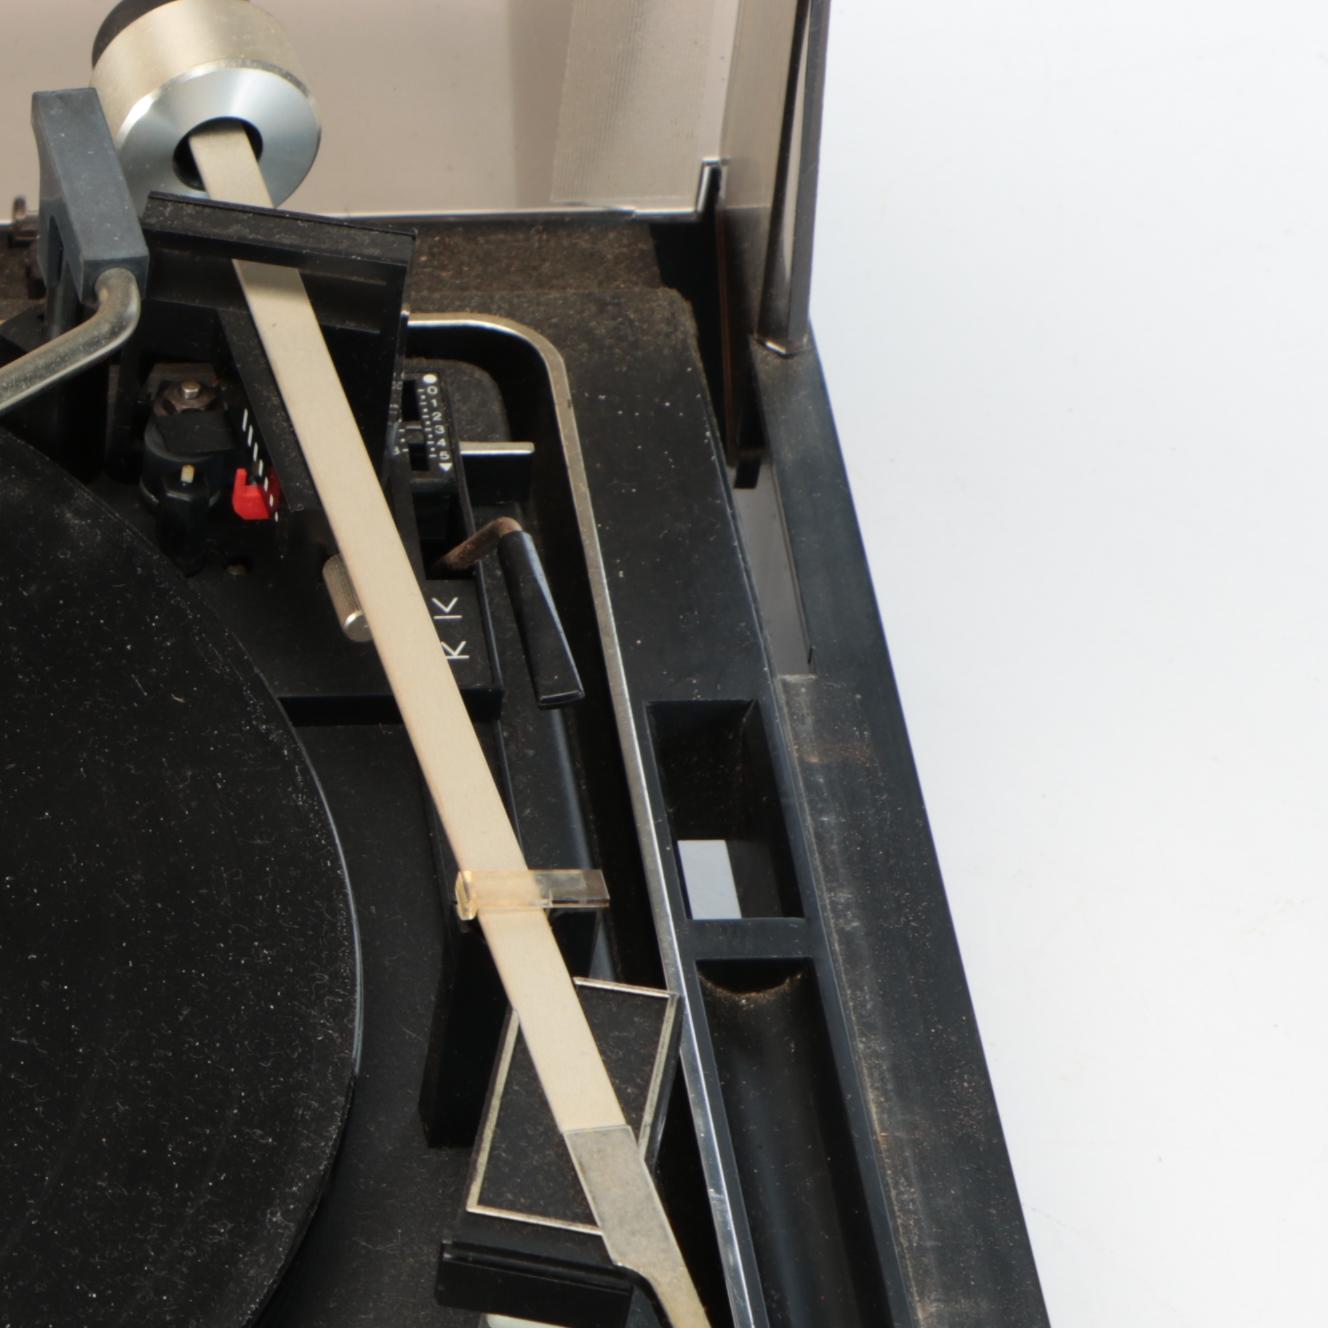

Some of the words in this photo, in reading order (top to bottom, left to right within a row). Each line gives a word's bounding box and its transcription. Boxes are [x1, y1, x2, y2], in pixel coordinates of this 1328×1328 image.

[427, 386, 438, 395] 0
[432, 412, 442, 421] 2
[435, 425, 445, 434] 3
[436, 438, 446, 447] 4
[439, 451, 450, 460] 5
